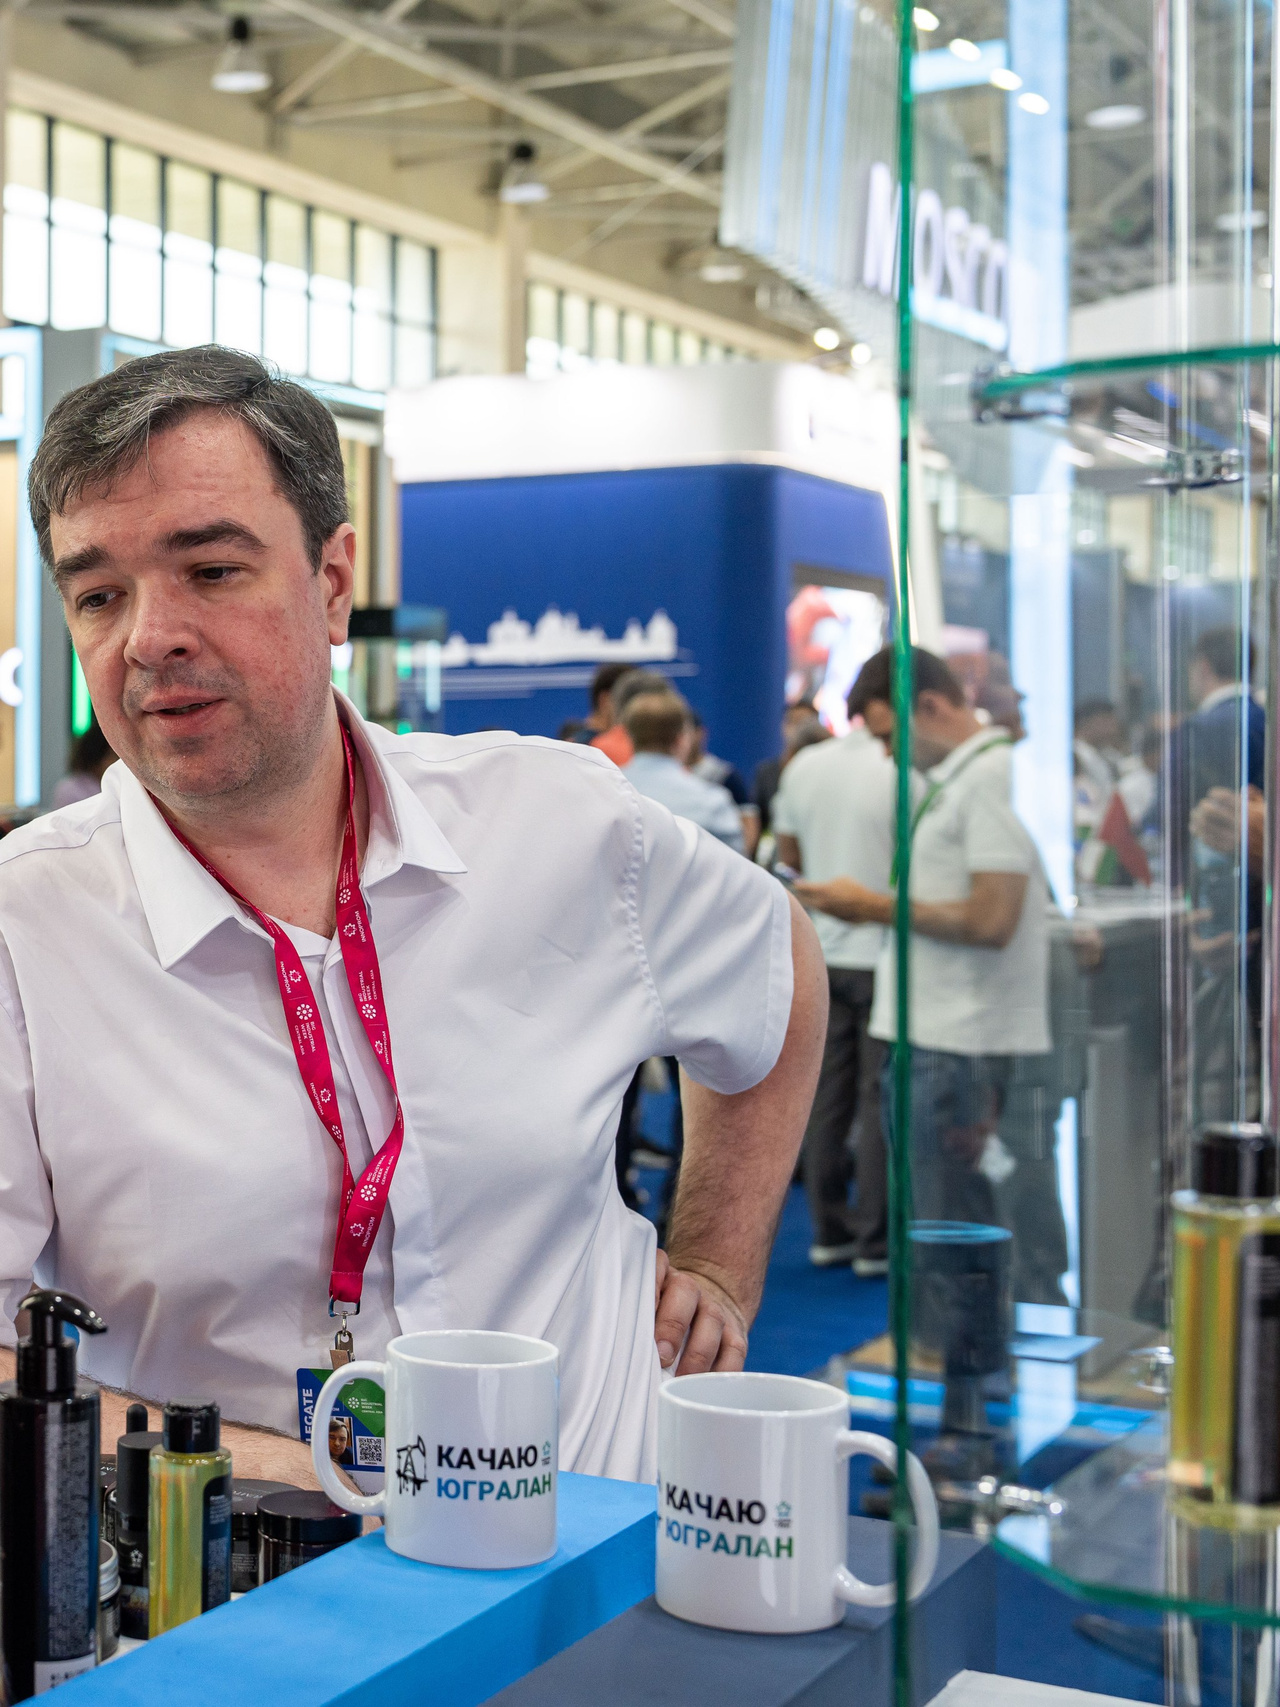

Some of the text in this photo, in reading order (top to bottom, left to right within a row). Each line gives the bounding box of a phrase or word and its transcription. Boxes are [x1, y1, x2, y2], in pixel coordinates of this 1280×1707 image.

[354, 910, 367, 942] INNOPROM
[280, 961, 291, 993] INNOPROM
[359, 971, 367, 1002] INDUSTRIAL
[305, 1022, 315, 1053] INDUSTRIAL
[309, 1082, 324, 1116] INNOPROM
[371, 1154, 387, 1183] INDUSTRIAL
[437, 1444, 538, 1470] КАЧАЮ
[437, 1472, 552, 1501] ЮГРАЛАН
[666, 1482, 766, 1525] КАЧАЮ
[666, 1517, 794, 1558] ЮГРАЛАН
